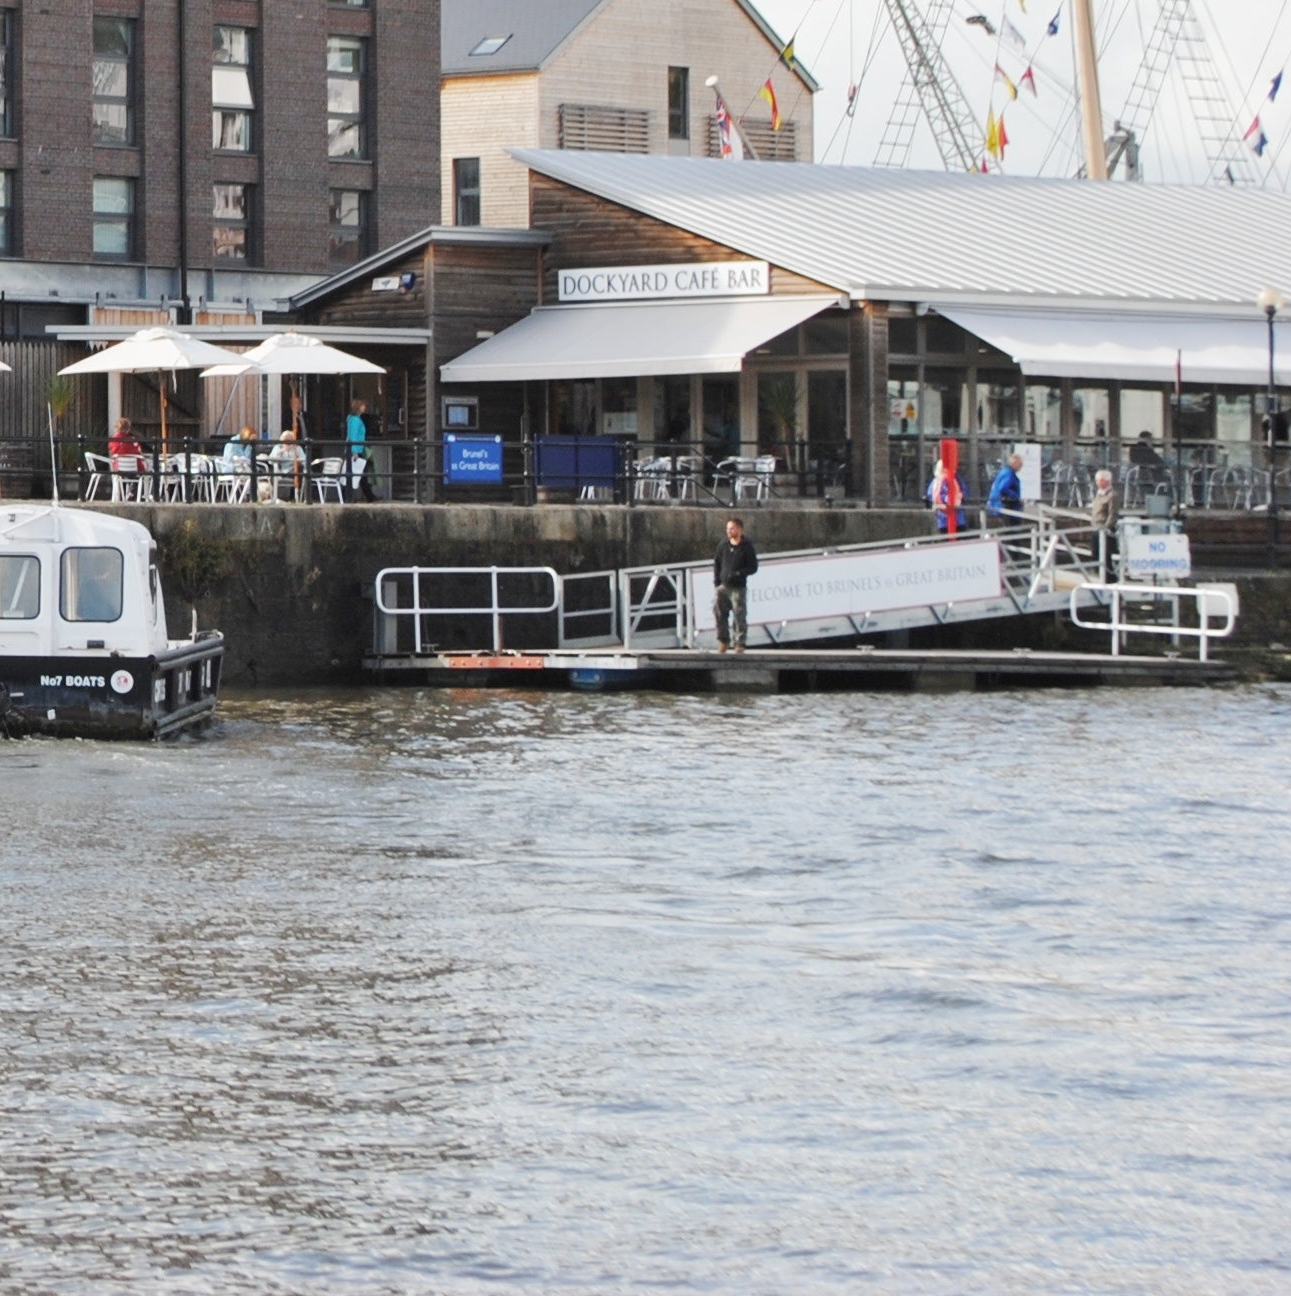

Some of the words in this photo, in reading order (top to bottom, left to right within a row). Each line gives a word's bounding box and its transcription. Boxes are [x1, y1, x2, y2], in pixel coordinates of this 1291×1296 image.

[563, 272, 668, 296] DOCKYARD
[675, 267, 719, 291] CAFÉ
[727, 268, 763, 290] BAR
[1149, 541, 1166, 552] NO
[748, 583, 803, 603] ELCOME
[806, 582, 823, 597] TO
[895, 569, 935, 587] GREAT
[938, 564, 987, 583] BRITAIN
[40, 675, 63, 686] No7
[65, 675, 105, 687] BOATS
